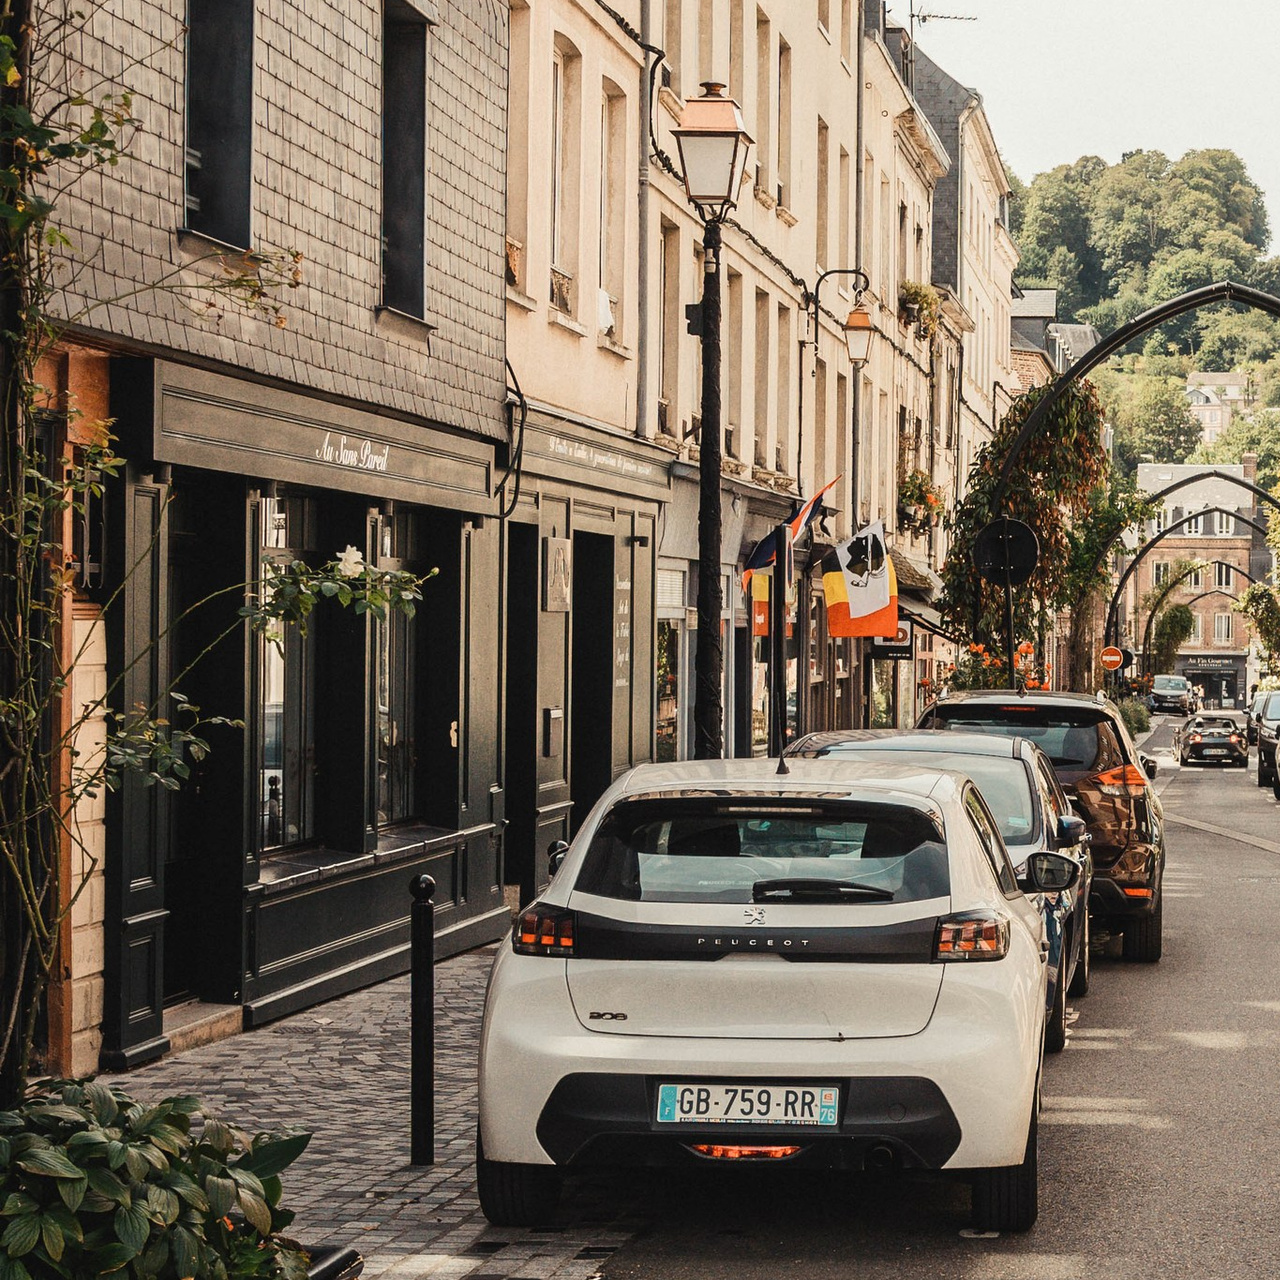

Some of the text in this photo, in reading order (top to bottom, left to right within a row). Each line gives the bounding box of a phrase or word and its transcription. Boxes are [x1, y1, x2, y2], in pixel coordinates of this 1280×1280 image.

[315, 431, 334, 462] Au
[698, 938, 809, 947] PEUGEOT
[589, 1011, 628, 1021] 208
[820, 1108, 835, 1121] 76
